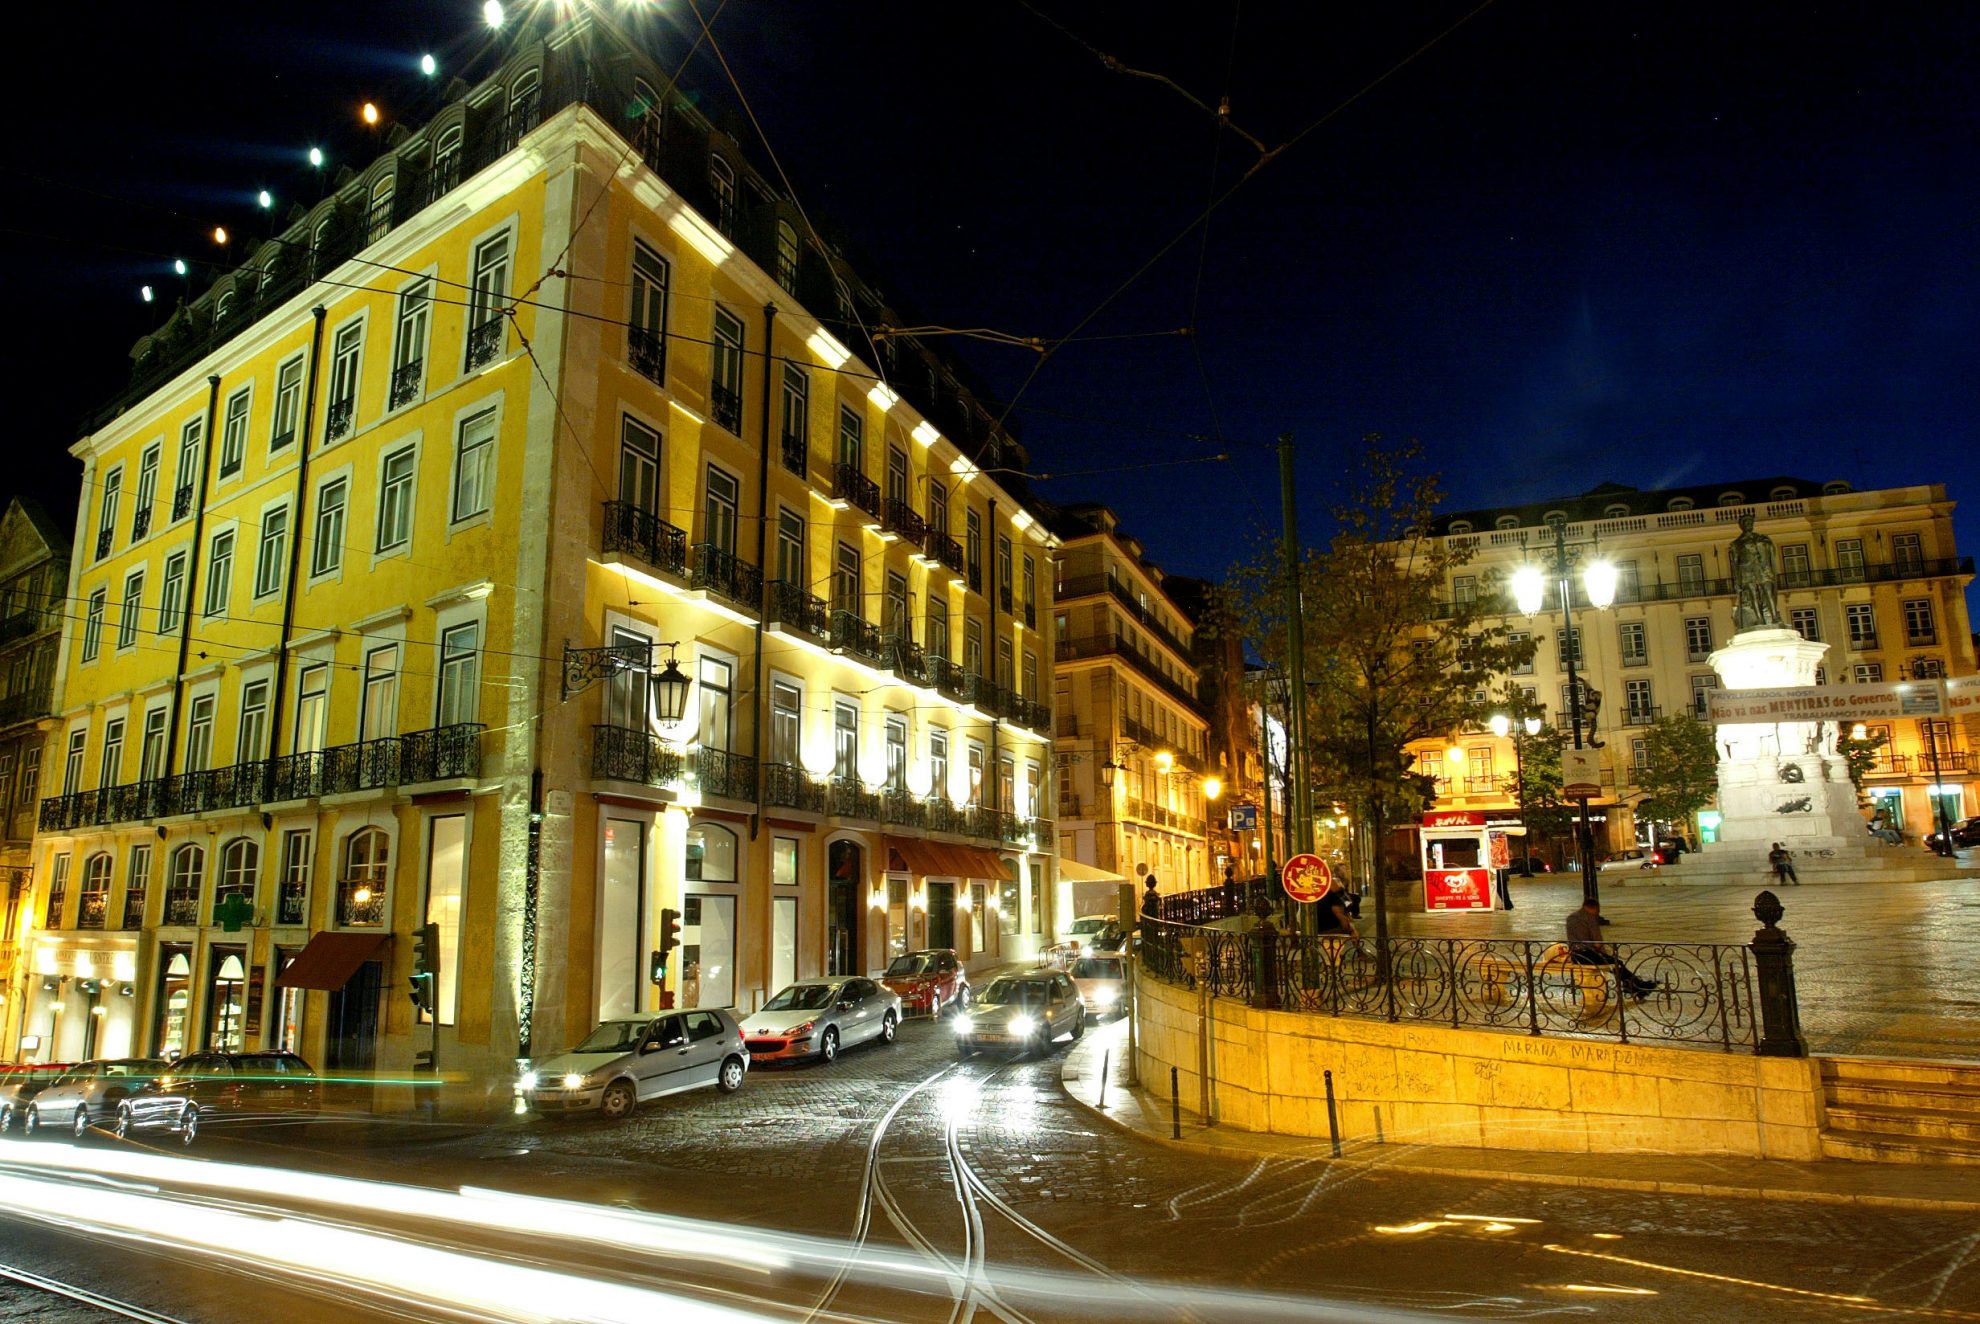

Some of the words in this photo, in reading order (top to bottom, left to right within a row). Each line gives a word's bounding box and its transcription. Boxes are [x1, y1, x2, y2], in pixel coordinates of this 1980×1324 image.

[1711, 706, 1732, 719] Não
[1749, 705, 1767, 715] nas
[1769, 696, 1830, 713] MENTIRAS
[1833, 696, 1846, 707] do
[1948, 695, 1971, 708] Não
[1783, 710, 1858, 719] TRABALHAMOS
[1860, 709, 1887, 717] PARA
[1233, 811, 1245, 826] P
